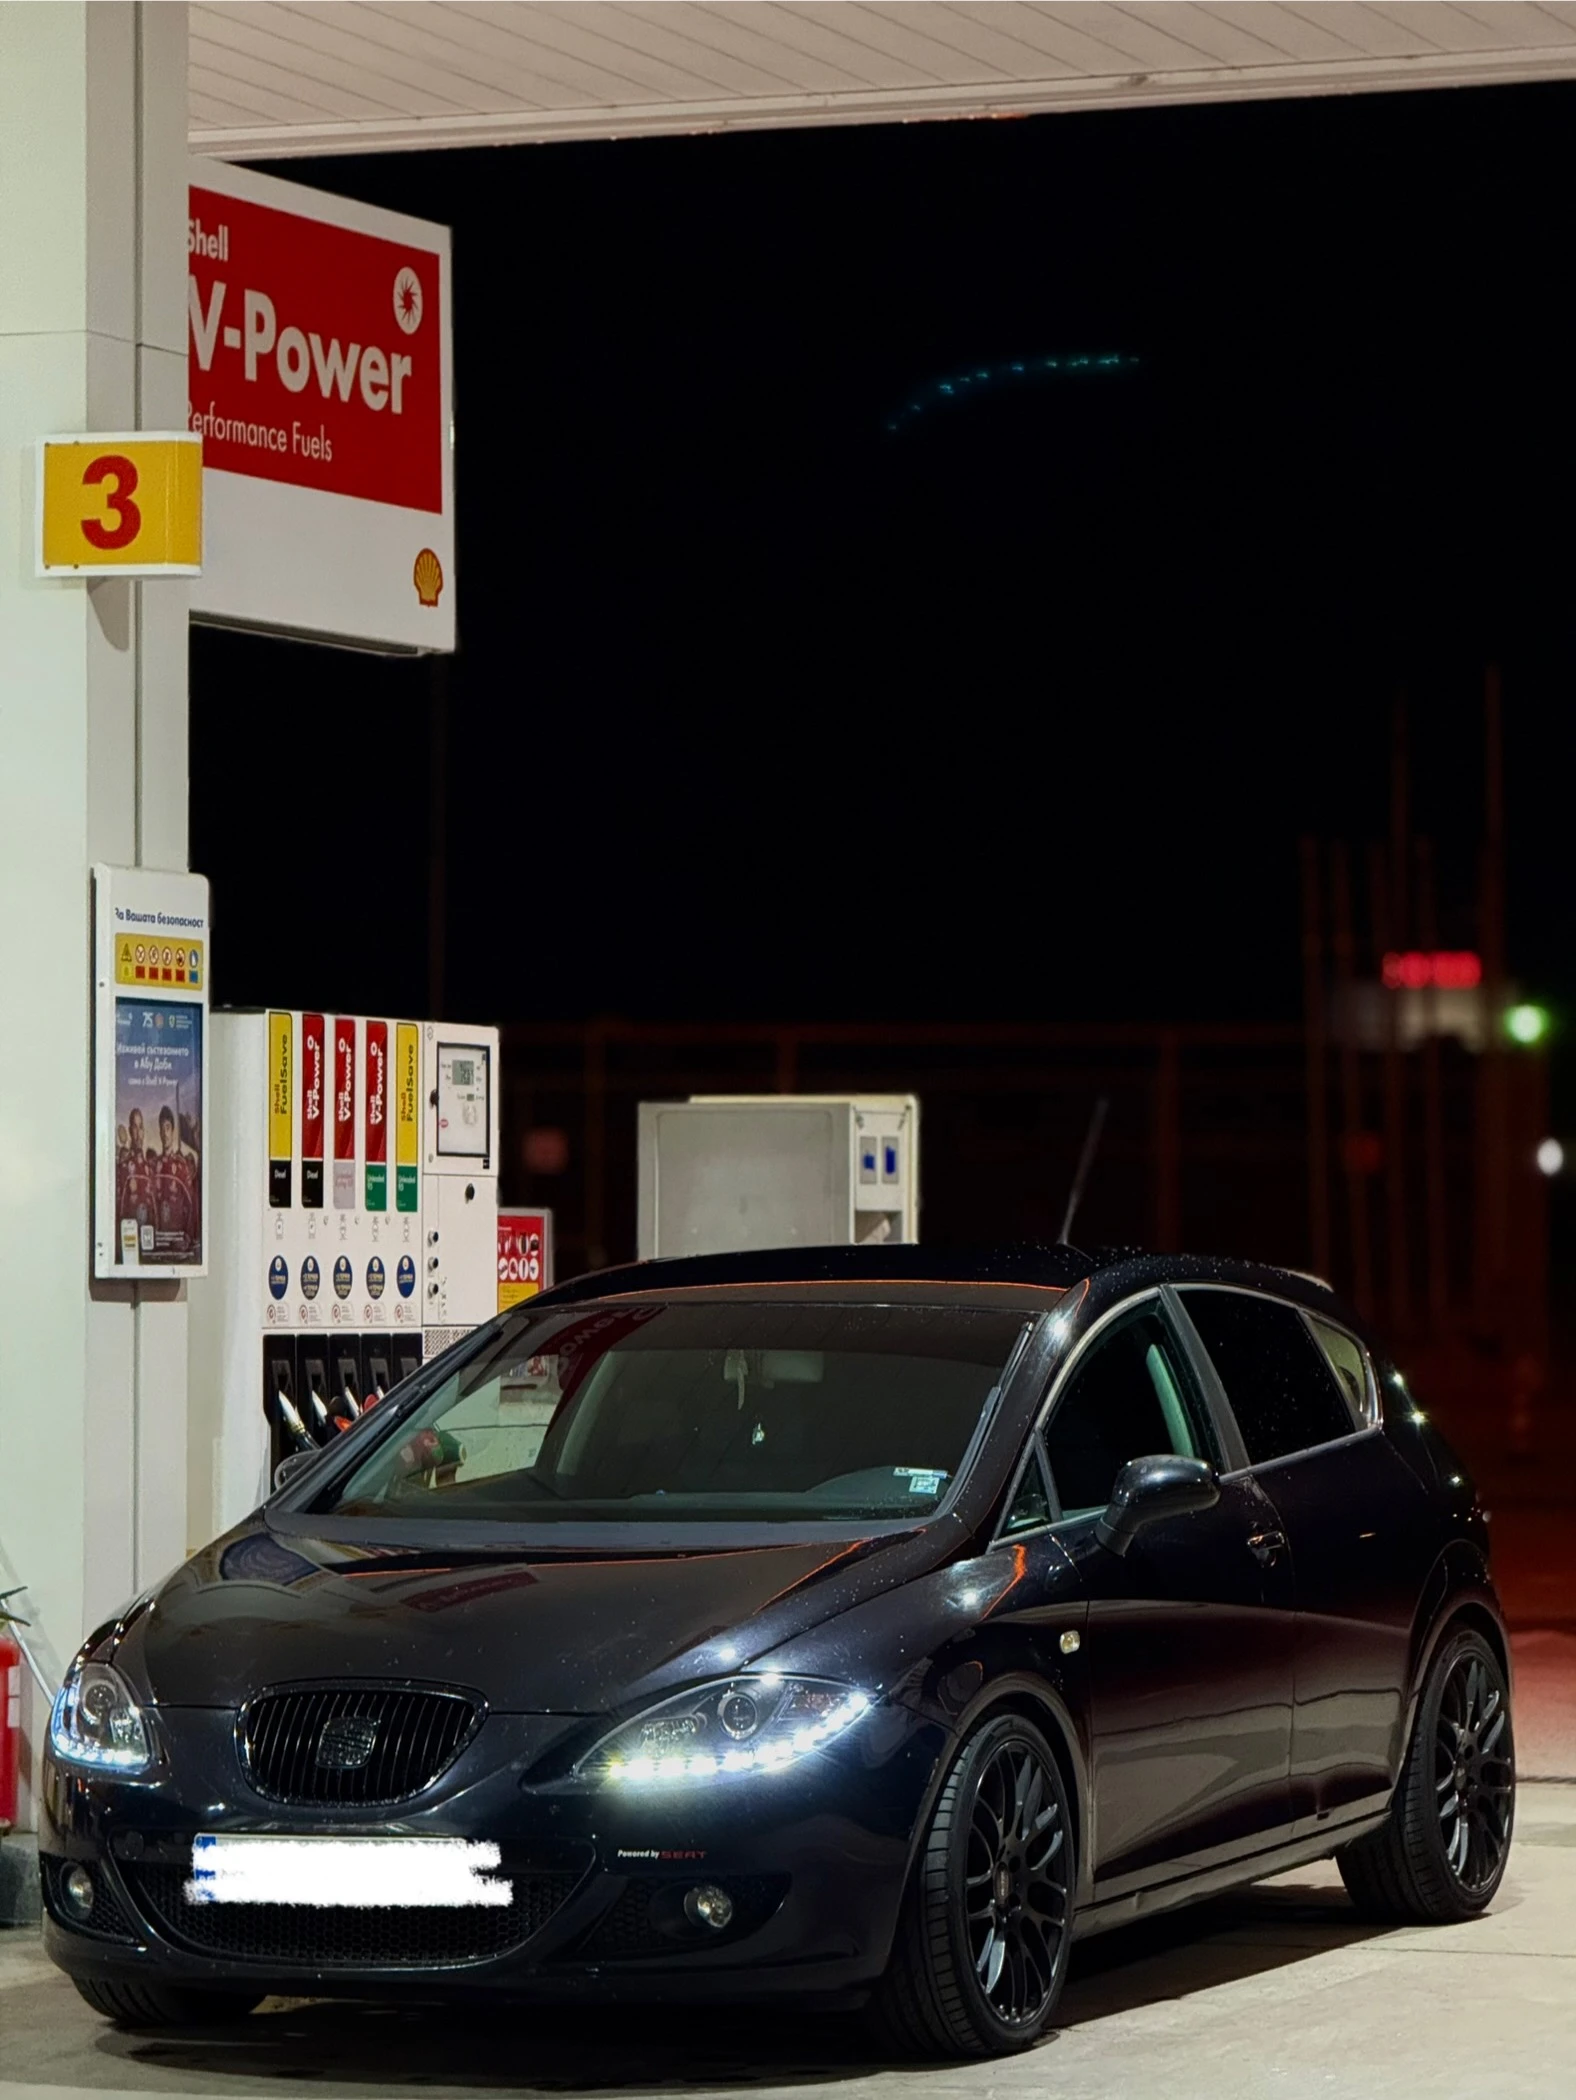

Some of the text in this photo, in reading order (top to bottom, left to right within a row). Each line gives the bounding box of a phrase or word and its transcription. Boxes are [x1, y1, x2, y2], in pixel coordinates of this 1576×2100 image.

[188, 273, 413, 415] V-Power
[292, 420, 333, 463] Fuels
[81, 455, 142, 550] 3
[125, 908, 156, 924] Вашата
[157, 911, 204, 928] безопасност
[280, 1034, 288, 1115] FuelSave
[312, 1040, 320, 1120] V-Power
[343, 1043, 351, 1121] V-Power
[375, 1048, 383, 1124] V-Power
[406, 1044, 414, 1122] FuelSave
[617, 1849, 705, 1860] Powered by SEAT
